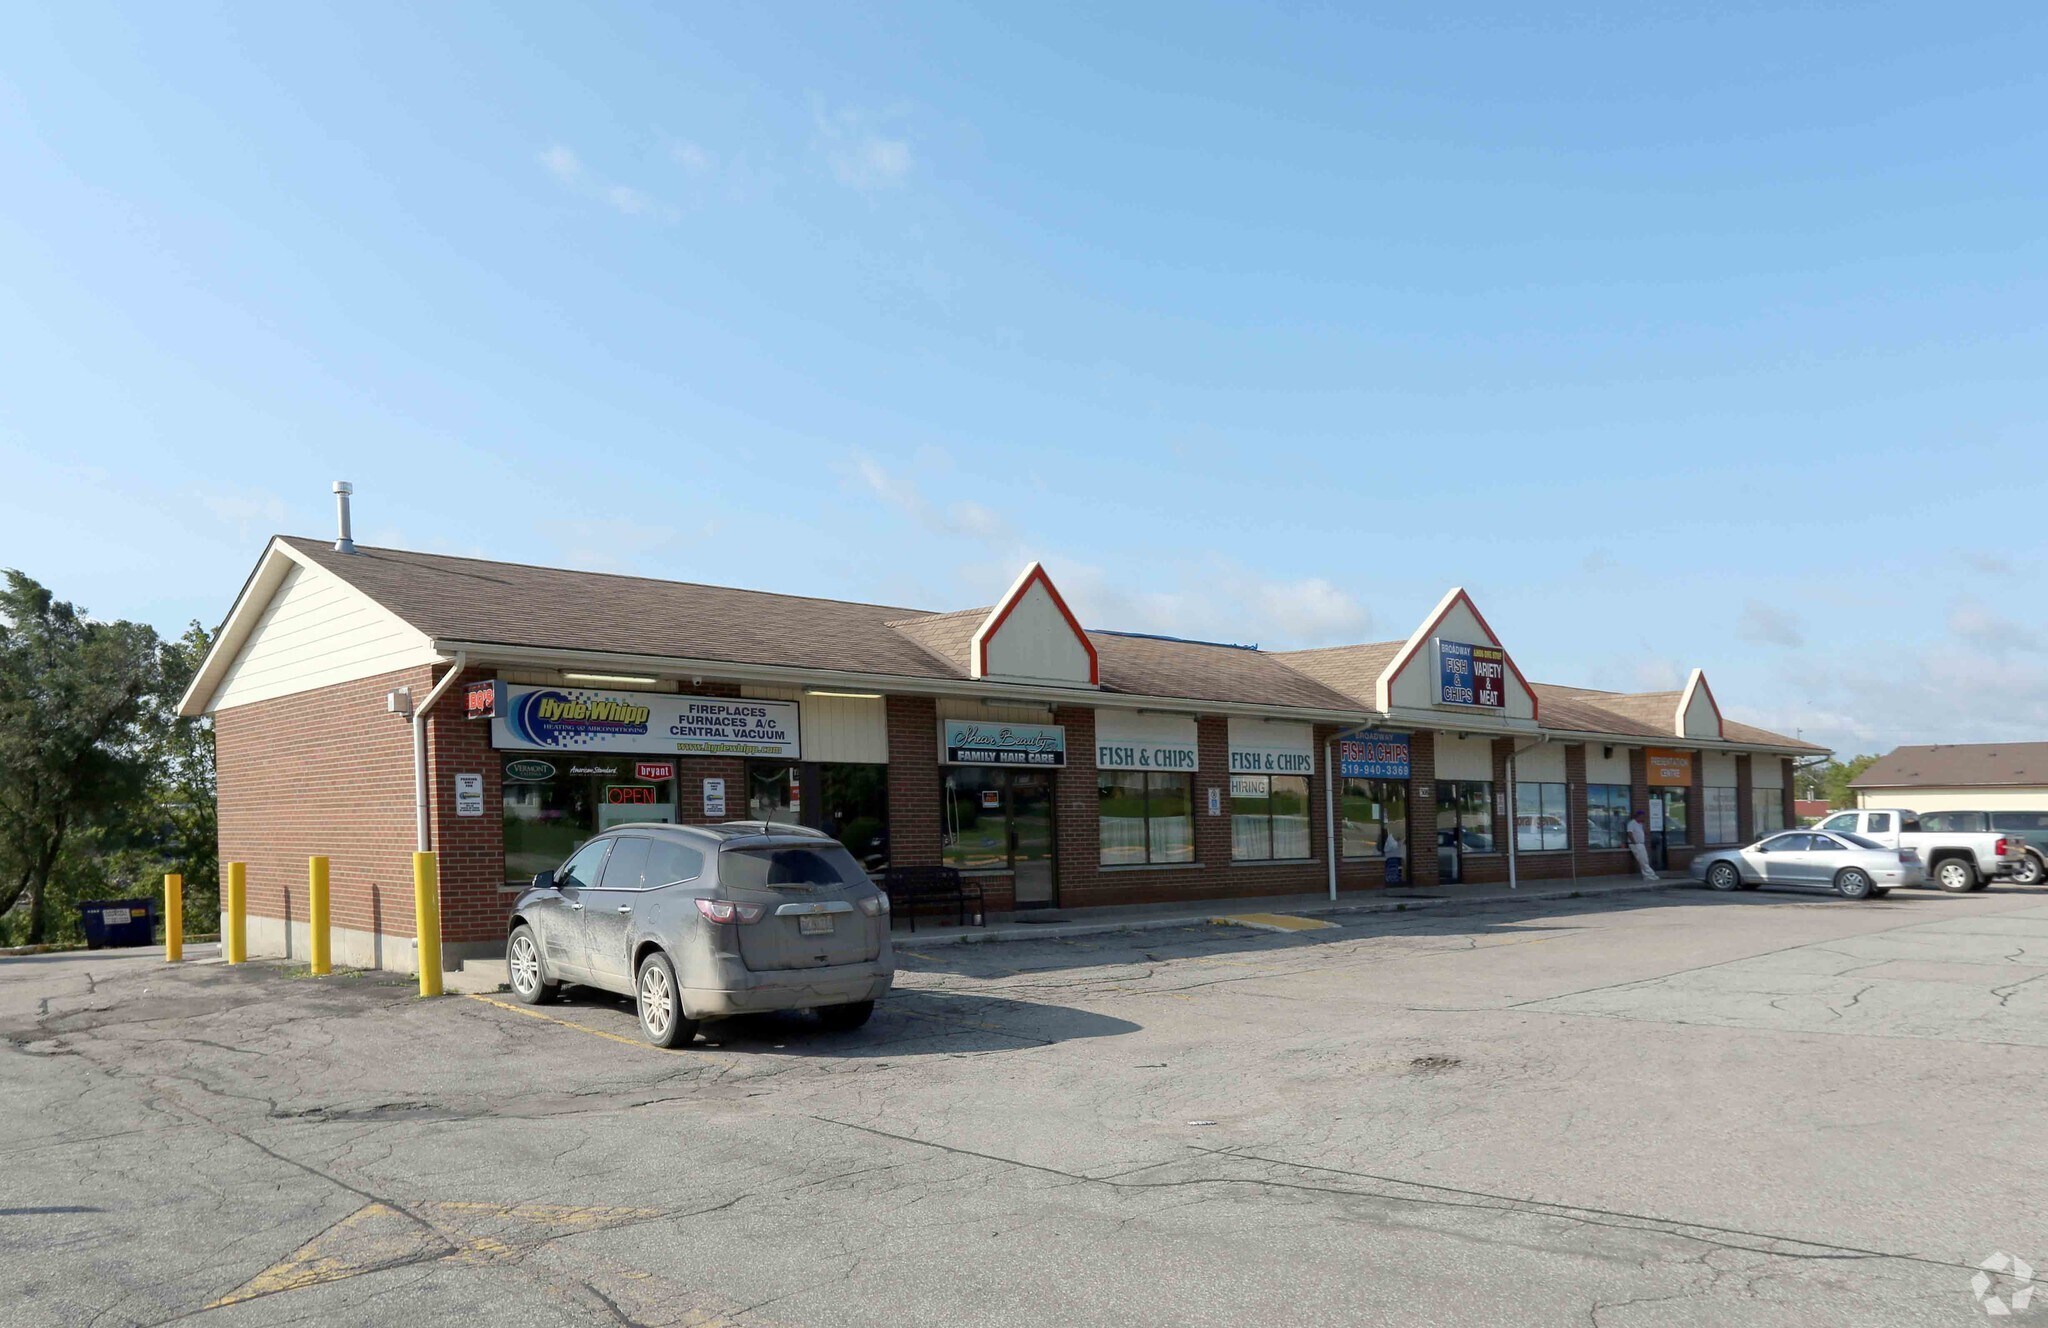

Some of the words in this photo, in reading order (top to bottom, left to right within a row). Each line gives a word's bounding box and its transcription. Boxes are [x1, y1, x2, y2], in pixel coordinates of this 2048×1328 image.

[1441, 643, 1471, 656] BROADWAY
[1445, 657, 1468, 675] FISH
[1473, 661, 1502, 679] VARIETY
[1454, 674, 1461, 686] &
[1485, 678, 1491, 690] &
[1443, 685, 1473, 703] CHIPS
[1479, 689, 1498, 705] MEAT
[539, 699, 586, 721] Hyde
[590, 701, 650, 725] Whipp
[689, 704, 767, 718] FIREPLACES
[543, 723, 575, 731] HEATING
[678, 715, 747, 728] FURNACES
[755, 719, 777, 729] A/C
[669, 725, 729, 738] CENTRAL
[733, 729, 785, 740] VACUUM
[954, 725, 996, 748] Shear
[997, 727, 1056, 753] Beauty
[677, 742, 782, 755] www.hydewhipp.com
[1340, 741, 1366, 762] FISH
[1367, 742, 1375, 763] &
[1376, 742, 1409, 764] CHIPS
[957, 750, 997, 762] FAMILY
[1000, 752, 1026, 763] HAIR
[1028, 753, 1055, 763] CARE
[1099, 746, 1135, 766] FISH
[1139, 748, 1150, 766] &
[1154, 749, 1195, 768] CHIPS
[1231, 752, 1260, 770] FISH
[1265, 753, 1274, 770] &
[1277, 754, 1311, 771] CHIPS
[513, 764, 548, 773] VERMONT
[569, 765, 594, 773] American
[593, 766, 618, 774] Standard
[641, 765, 669, 777] bryant
[1231, 780, 1265, 794] HIRING
[608, 788, 654, 805] OPEN
